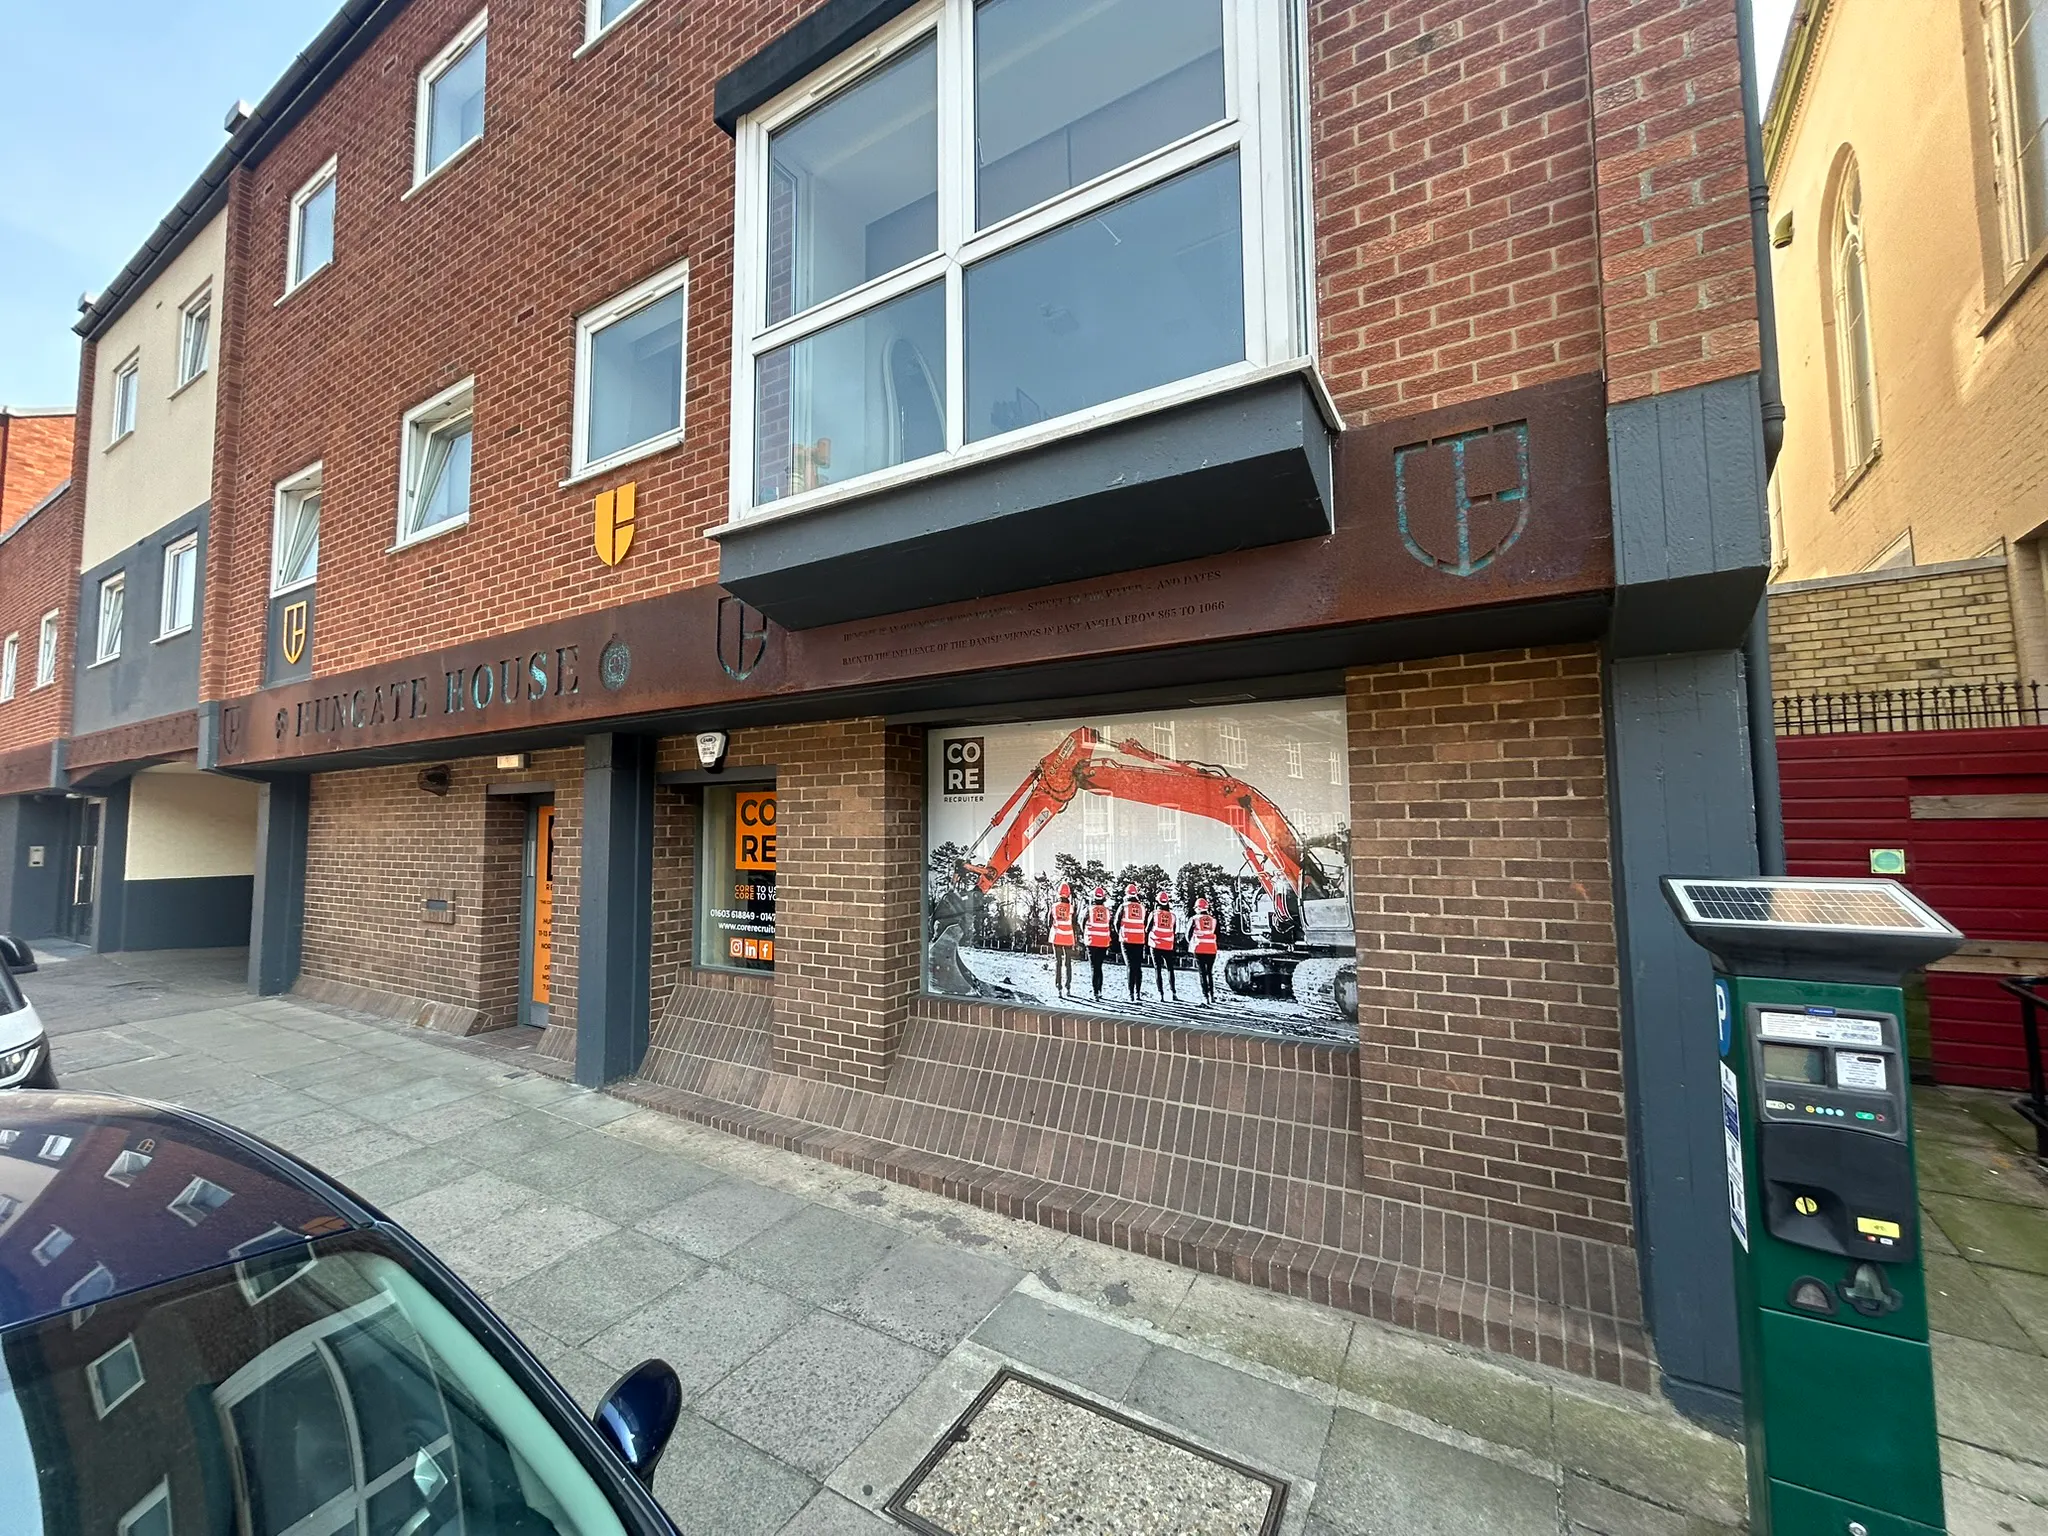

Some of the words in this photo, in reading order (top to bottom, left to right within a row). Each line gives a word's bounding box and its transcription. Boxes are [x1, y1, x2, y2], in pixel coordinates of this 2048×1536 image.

[1156, 577, 1181, 590] AND
[1183, 570, 1222, 585] DATES
[863, 653, 874, 663] TO
[891, 643, 936, 659] INFLUENCE
[937, 642, 949, 652] OF
[949, 639, 968, 650] THE
[1003, 627, 1042, 641] VIKINGS
[1043, 625, 1055, 636] IN
[1056, 621, 1082, 635] EAST
[1123, 610, 1155, 625] FROM
[1157, 607, 1177, 619] 865
[1178, 604, 1196, 616] TO
[1198, 600, 1226, 613] 1066
[296, 677, 428, 738] HUNGATE
[444, 644, 580, 714] HOUSE
[946, 741, 981, 764] CO
[948, 768, 980, 790] RE
[734, 884, 755, 893] CORE
[756, 885, 767, 893] TO
[734, 892, 755, 900] CORE
[756, 893, 767, 901] TO
[710, 908, 730, 918] 01603
